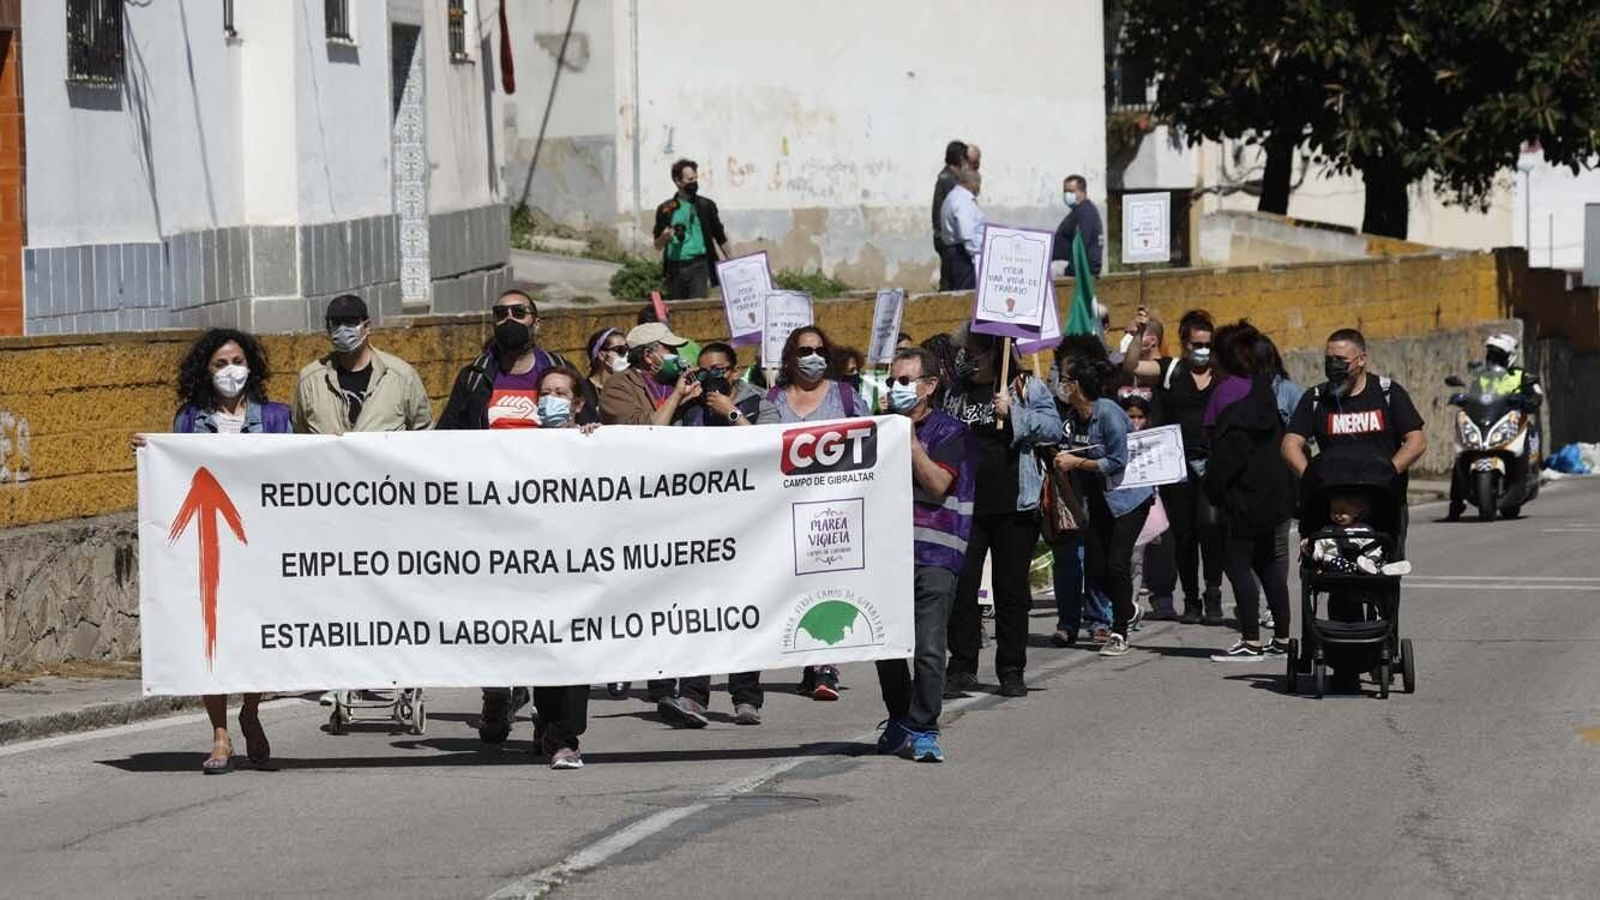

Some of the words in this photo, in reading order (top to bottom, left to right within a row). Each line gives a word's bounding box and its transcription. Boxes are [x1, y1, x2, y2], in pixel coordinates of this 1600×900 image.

[1333, 411, 1381, 434] NERVA
[789, 427, 871, 468] CGT
[261, 474, 416, 507] REDUCCIÓN
[424, 481, 459, 505] DE
[468, 480, 501, 506] LA
[507, 476, 633, 505] JORNADA
[639, 467, 755, 499] LABORAL
[783, 477, 812, 488] CAMPO
[814, 476, 825, 485] DE
[827, 472, 874, 484] GIBRALTAR
[808, 531, 850, 547] VIOLETA
[811, 517, 848, 532] MAREA
[281, 550, 389, 578] EMPLEO
[397, 550, 481, 575] DIGNO
[489, 549, 560, 575] PARA
[566, 546, 615, 573] LAS
[623, 537, 736, 570] MUJERES
[260, 620, 431, 649] ESTABILIDAD
[439, 619, 563, 645] LABORAL
[570, 616, 603, 642] EN
[611, 612, 644, 639] LO
[651, 603, 760, 636] PÚBLICO
